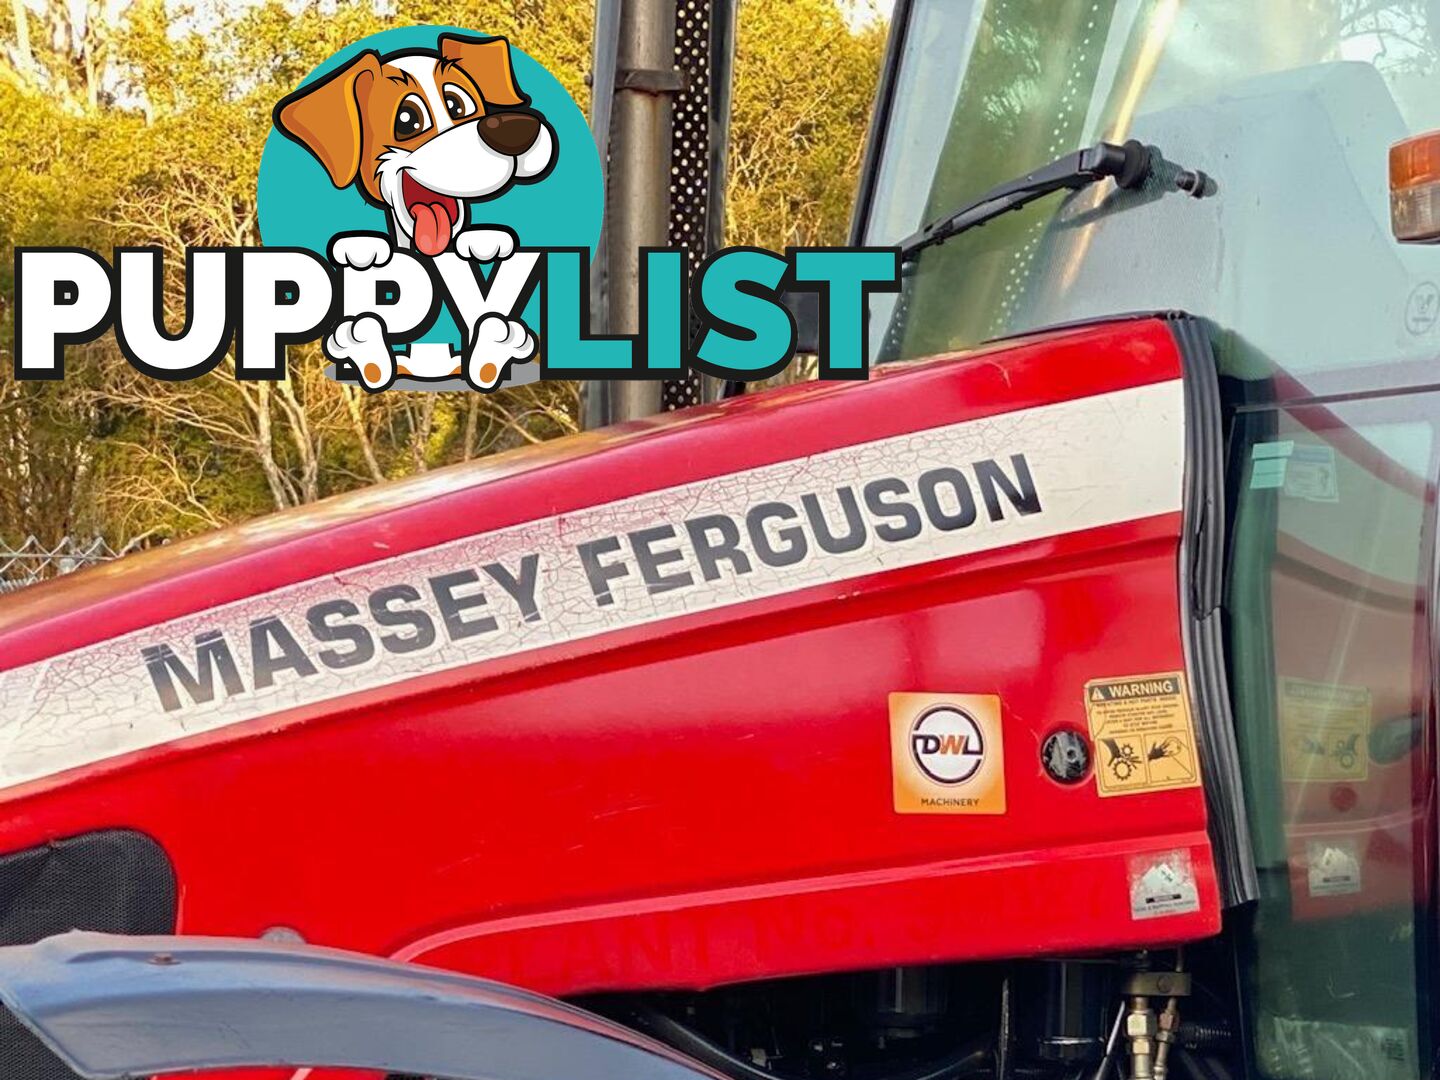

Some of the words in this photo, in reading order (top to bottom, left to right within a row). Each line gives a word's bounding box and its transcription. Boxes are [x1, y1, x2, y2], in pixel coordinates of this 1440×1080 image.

[140, 553, 541, 712] MASSEY
[579, 452, 1043, 606] FERGUSON
[1108, 680, 1174, 698] WARNING
[913, 734, 983, 755] DWL
[921, 798, 979, 807] MACHINERY
